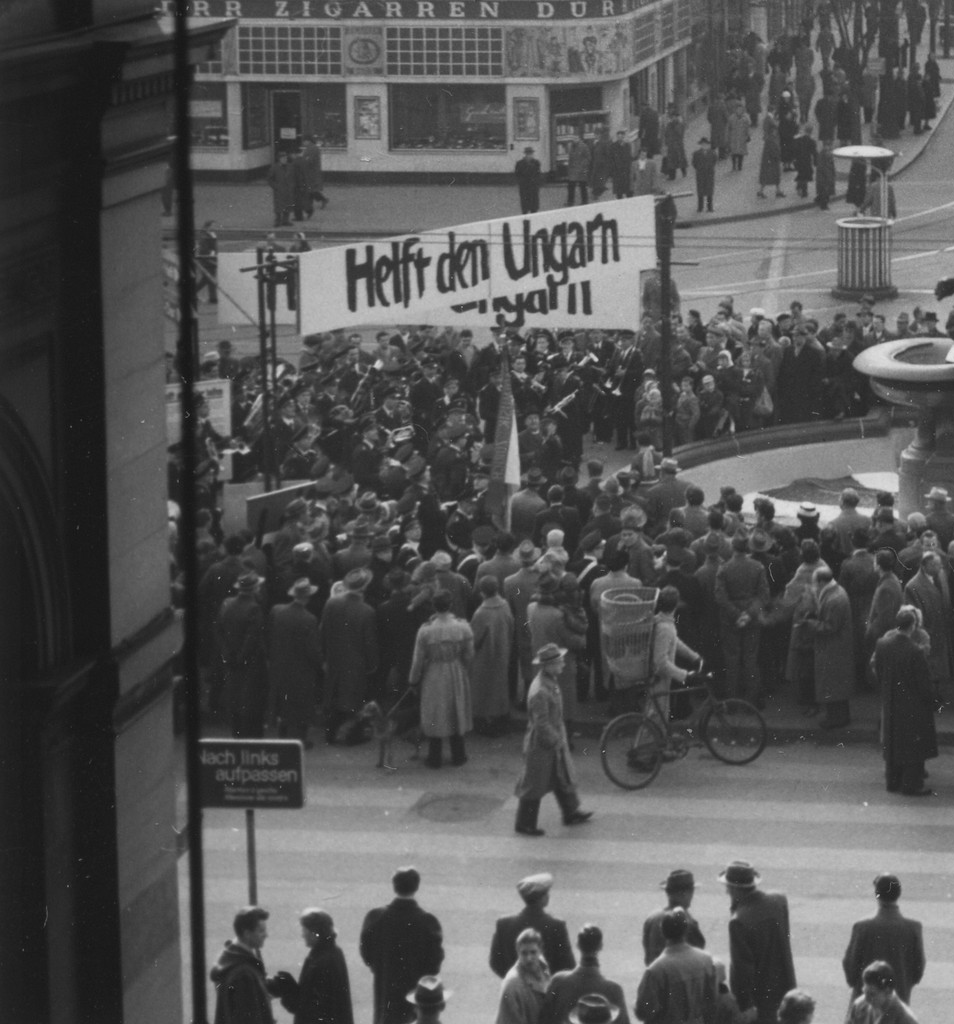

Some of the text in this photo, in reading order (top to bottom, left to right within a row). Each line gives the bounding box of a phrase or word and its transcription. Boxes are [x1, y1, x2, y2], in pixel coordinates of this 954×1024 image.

[276, 1, 499, 18] ZIGARREN
[345, 236, 431, 312] Helft
[436, 231, 490, 294] den
[503, 213, 620, 287] Ungarn
[241, 750, 279, 765] links
[216, 766, 298, 783] aufpassen
